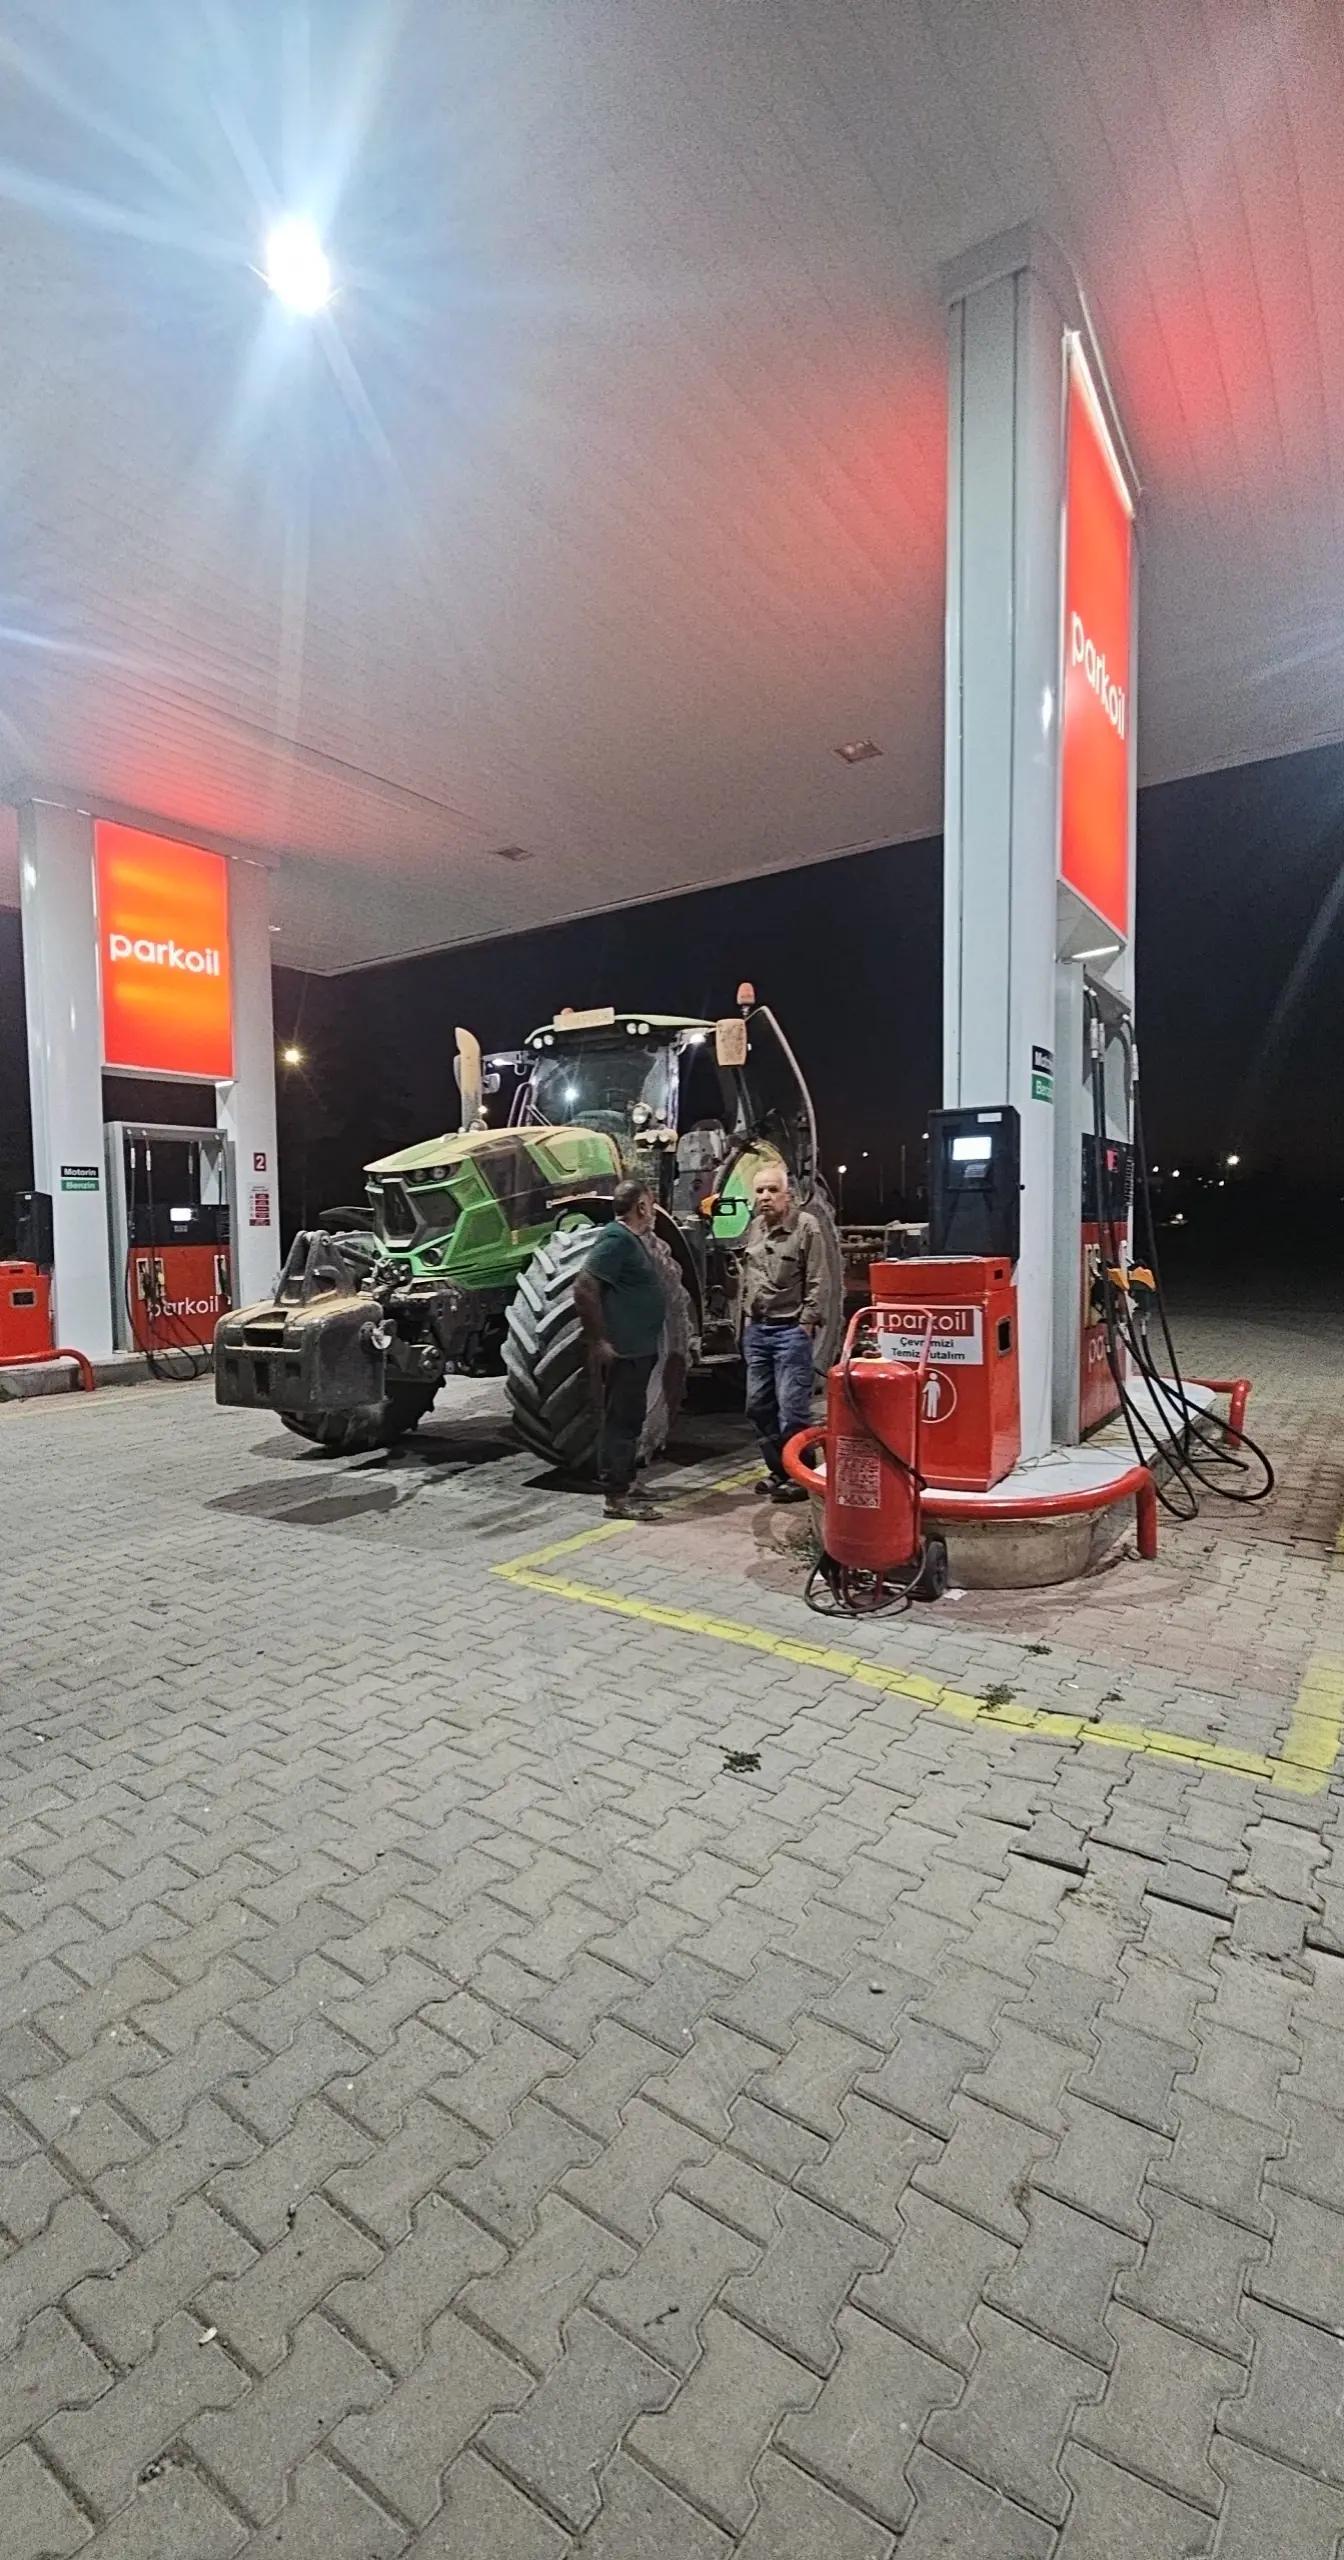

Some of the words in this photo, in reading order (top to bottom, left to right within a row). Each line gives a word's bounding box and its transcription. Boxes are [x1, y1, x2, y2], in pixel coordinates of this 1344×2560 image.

[1071, 611, 1125, 740] parkoil
[109, 933, 219, 976] parkoil
[255, 1154, 265, 1170] 2
[900, 1337, 954, 1348] Çevrmizi
[925, 1350, 966, 1360] utalım
